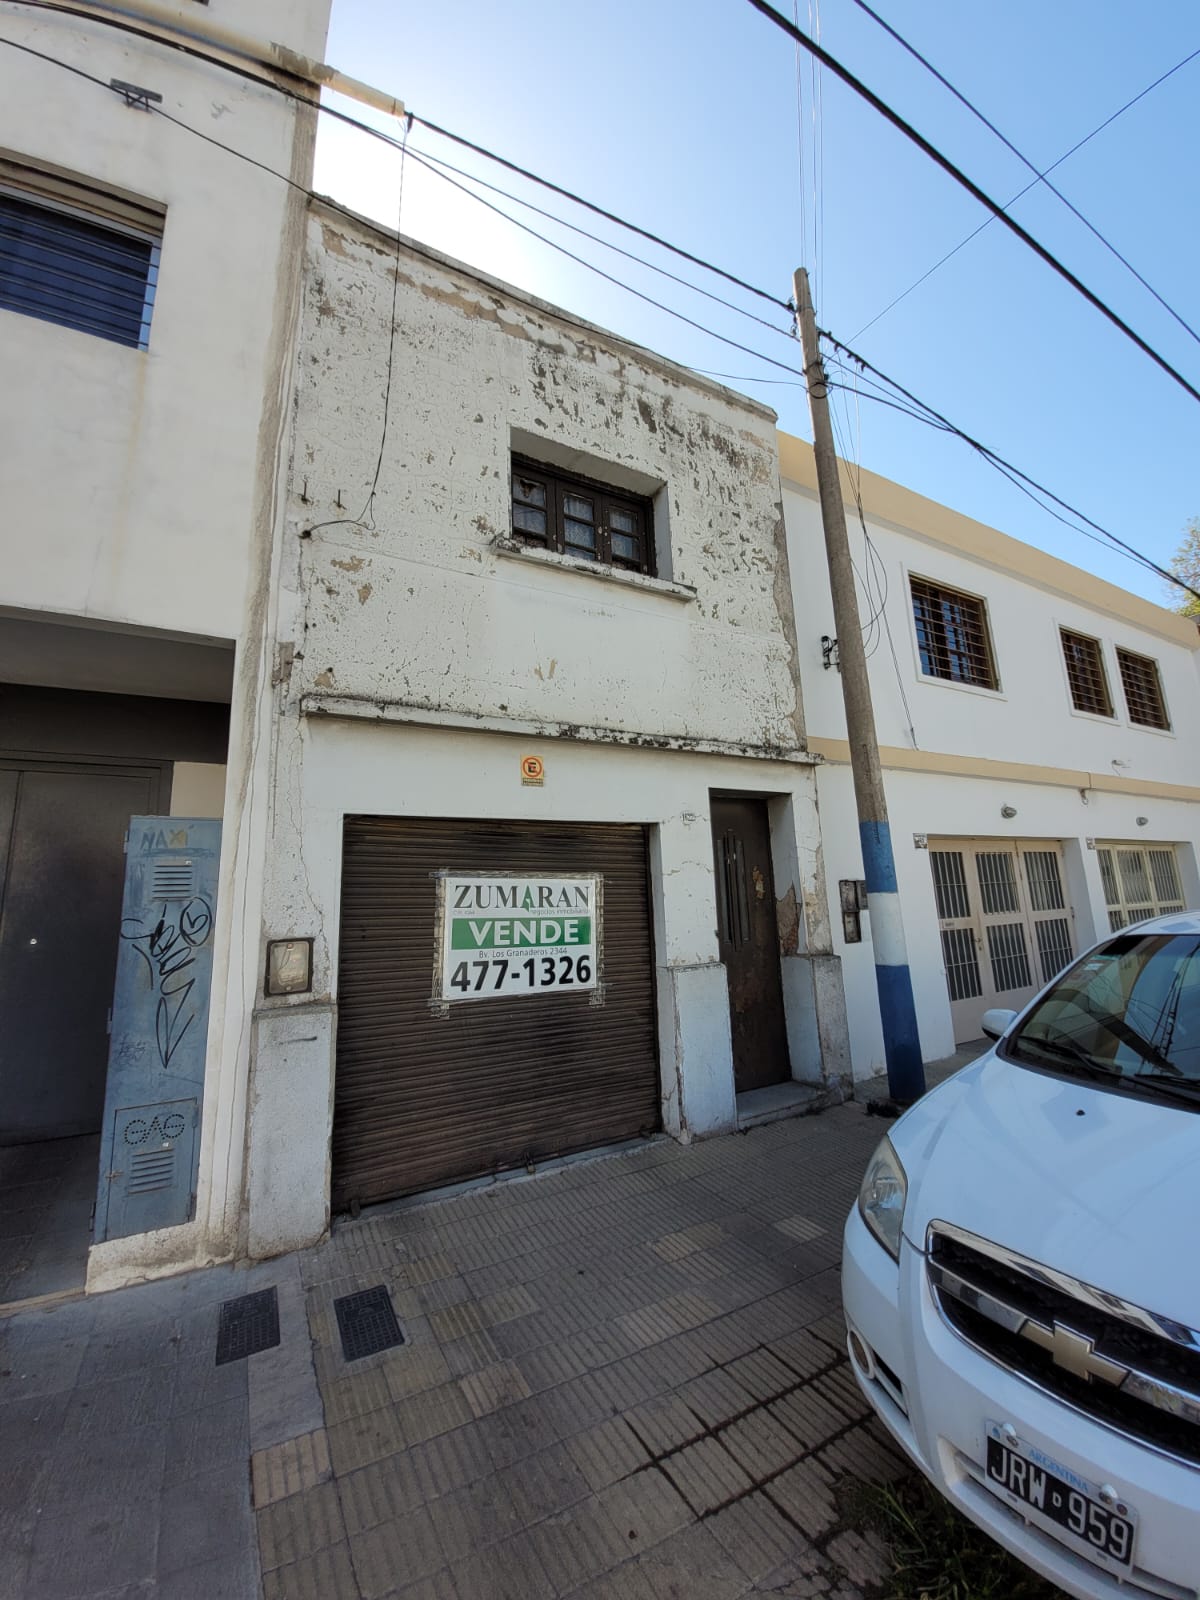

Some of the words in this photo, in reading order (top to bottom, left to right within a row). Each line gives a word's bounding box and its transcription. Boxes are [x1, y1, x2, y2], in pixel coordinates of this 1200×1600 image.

[453, 885, 590, 912] ZUMARAN
[469, 919, 579, 946] VENDE
[492, 950, 505, 958] Los
[506, 947, 548, 957] Granaderos
[450, 954, 592, 992] 477-1326
[124, 1113, 186, 1145] GAS
[990, 1447, 1047, 1511] JRW
[1067, 1491, 1130, 1560] 959
